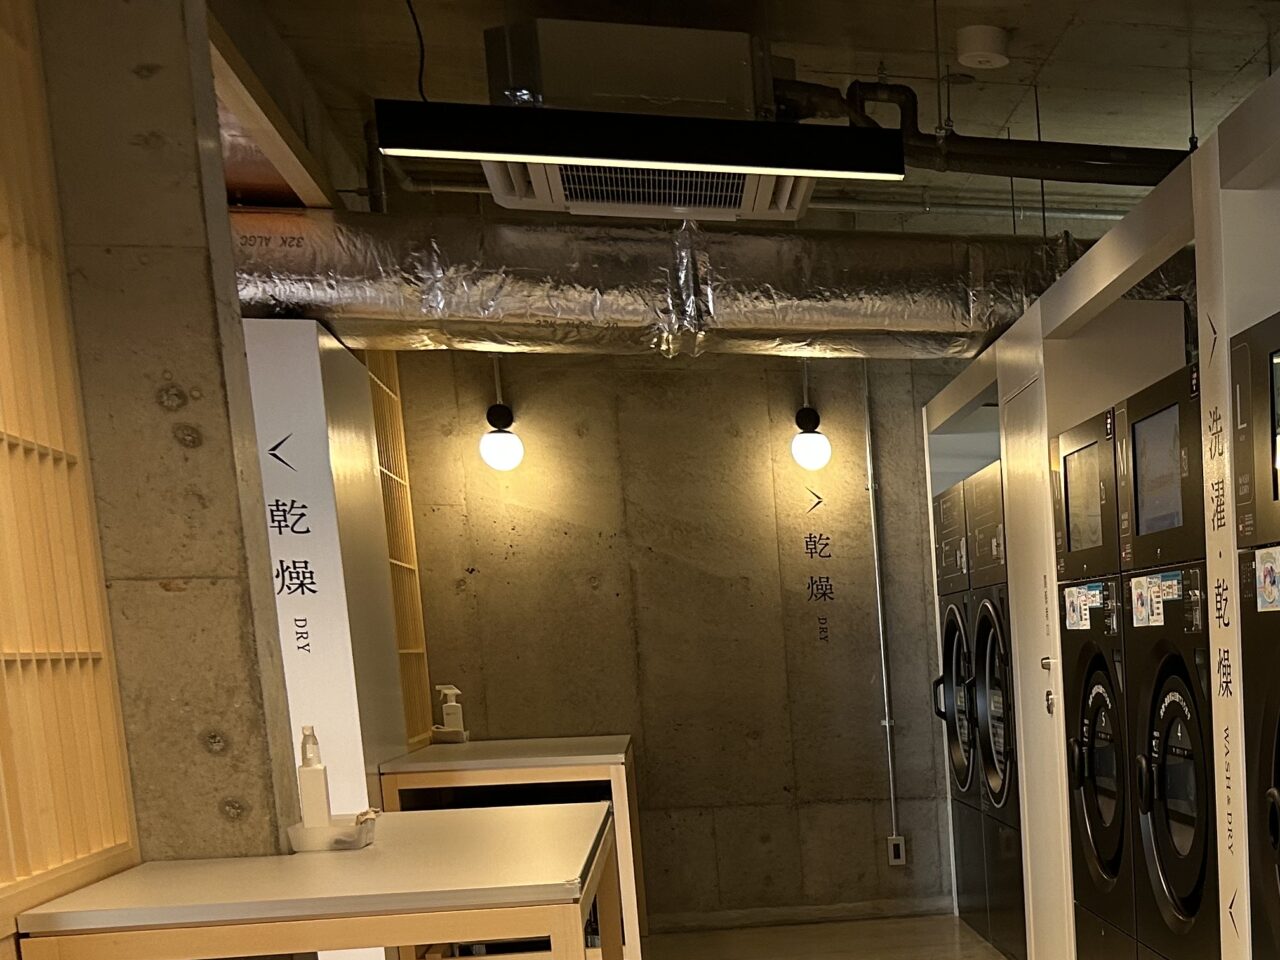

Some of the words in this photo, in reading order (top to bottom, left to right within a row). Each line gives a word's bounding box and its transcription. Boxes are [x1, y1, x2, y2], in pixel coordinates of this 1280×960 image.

[267, 498, 318, 596] 乾燥
[803, 532, 835, 603] 乾燥
[1208, 406, 1233, 698] 洗濯・乾燥
[293, 617, 312, 655] DRY
[817, 616, 830, 643] DRY
[1223, 725, 1231, 790] WASH
[1226, 812, 1234, 856] DRY
